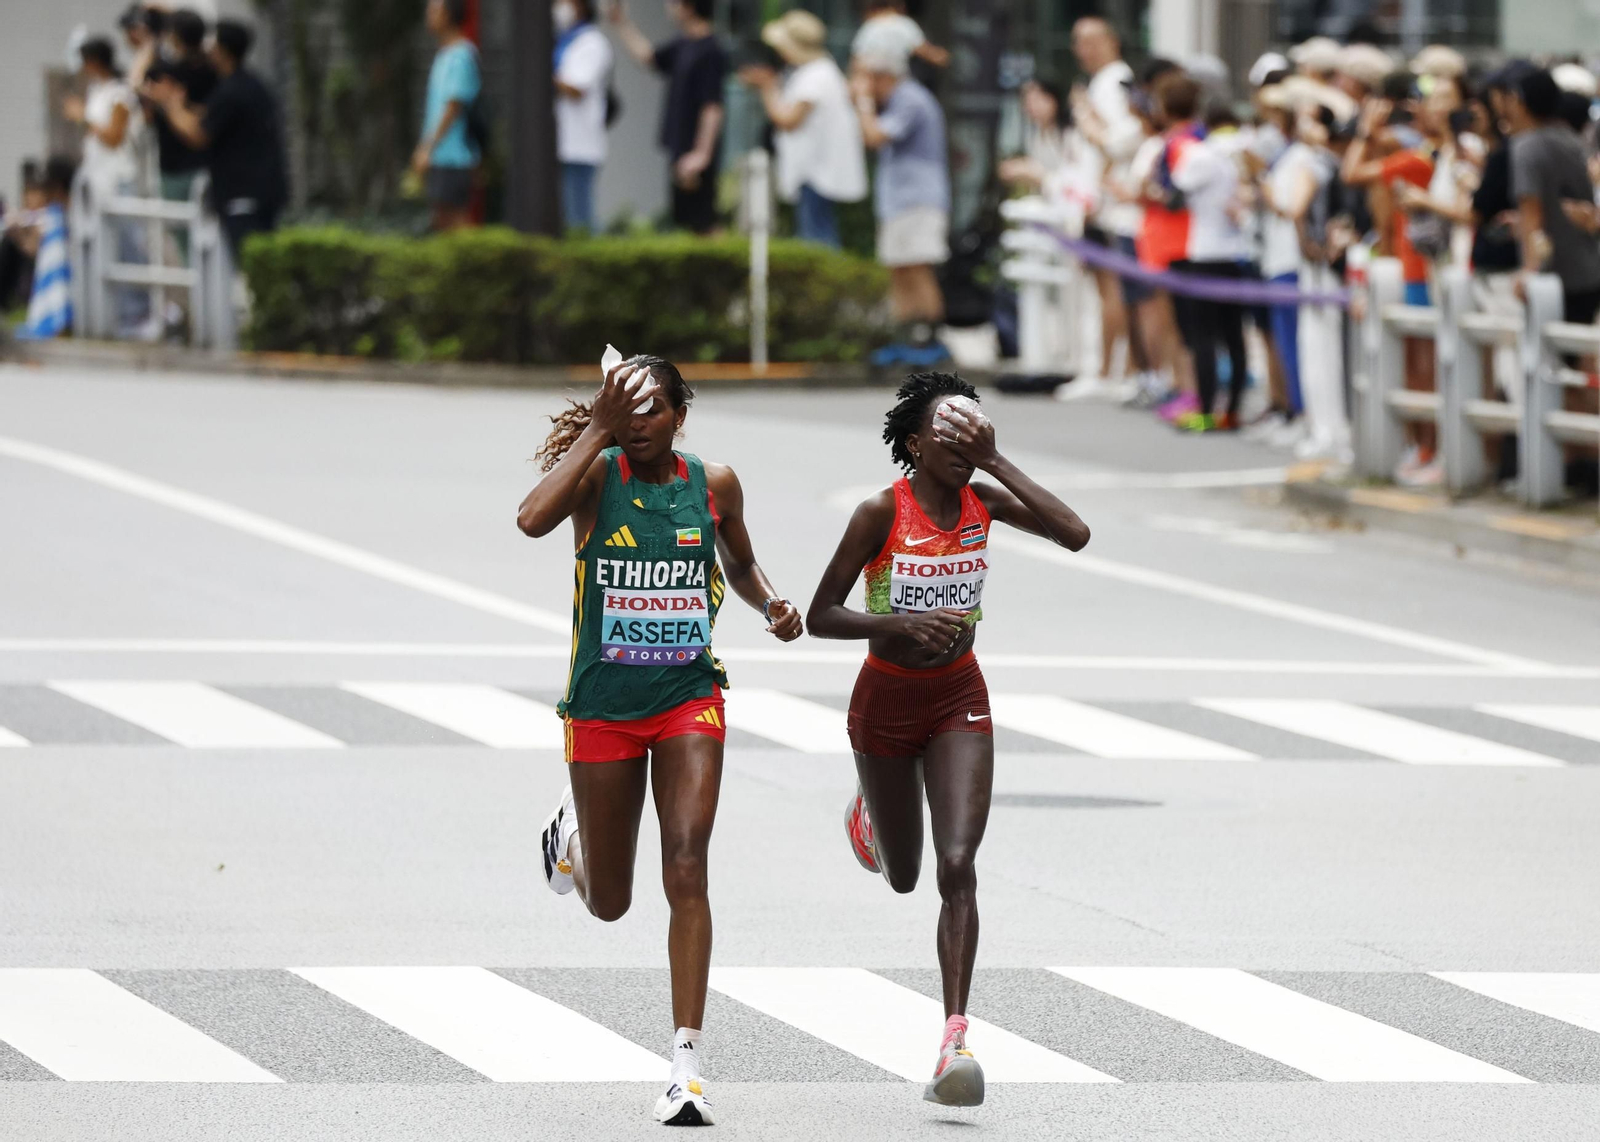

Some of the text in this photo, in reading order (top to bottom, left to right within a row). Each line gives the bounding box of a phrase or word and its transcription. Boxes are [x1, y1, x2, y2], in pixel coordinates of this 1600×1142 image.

[596, 557, 706, 588] ETHIOPIA
[895, 557, 989, 577] HONDA
[605, 595, 706, 611] HONDA
[608, 620, 705, 644] ASSEFA
